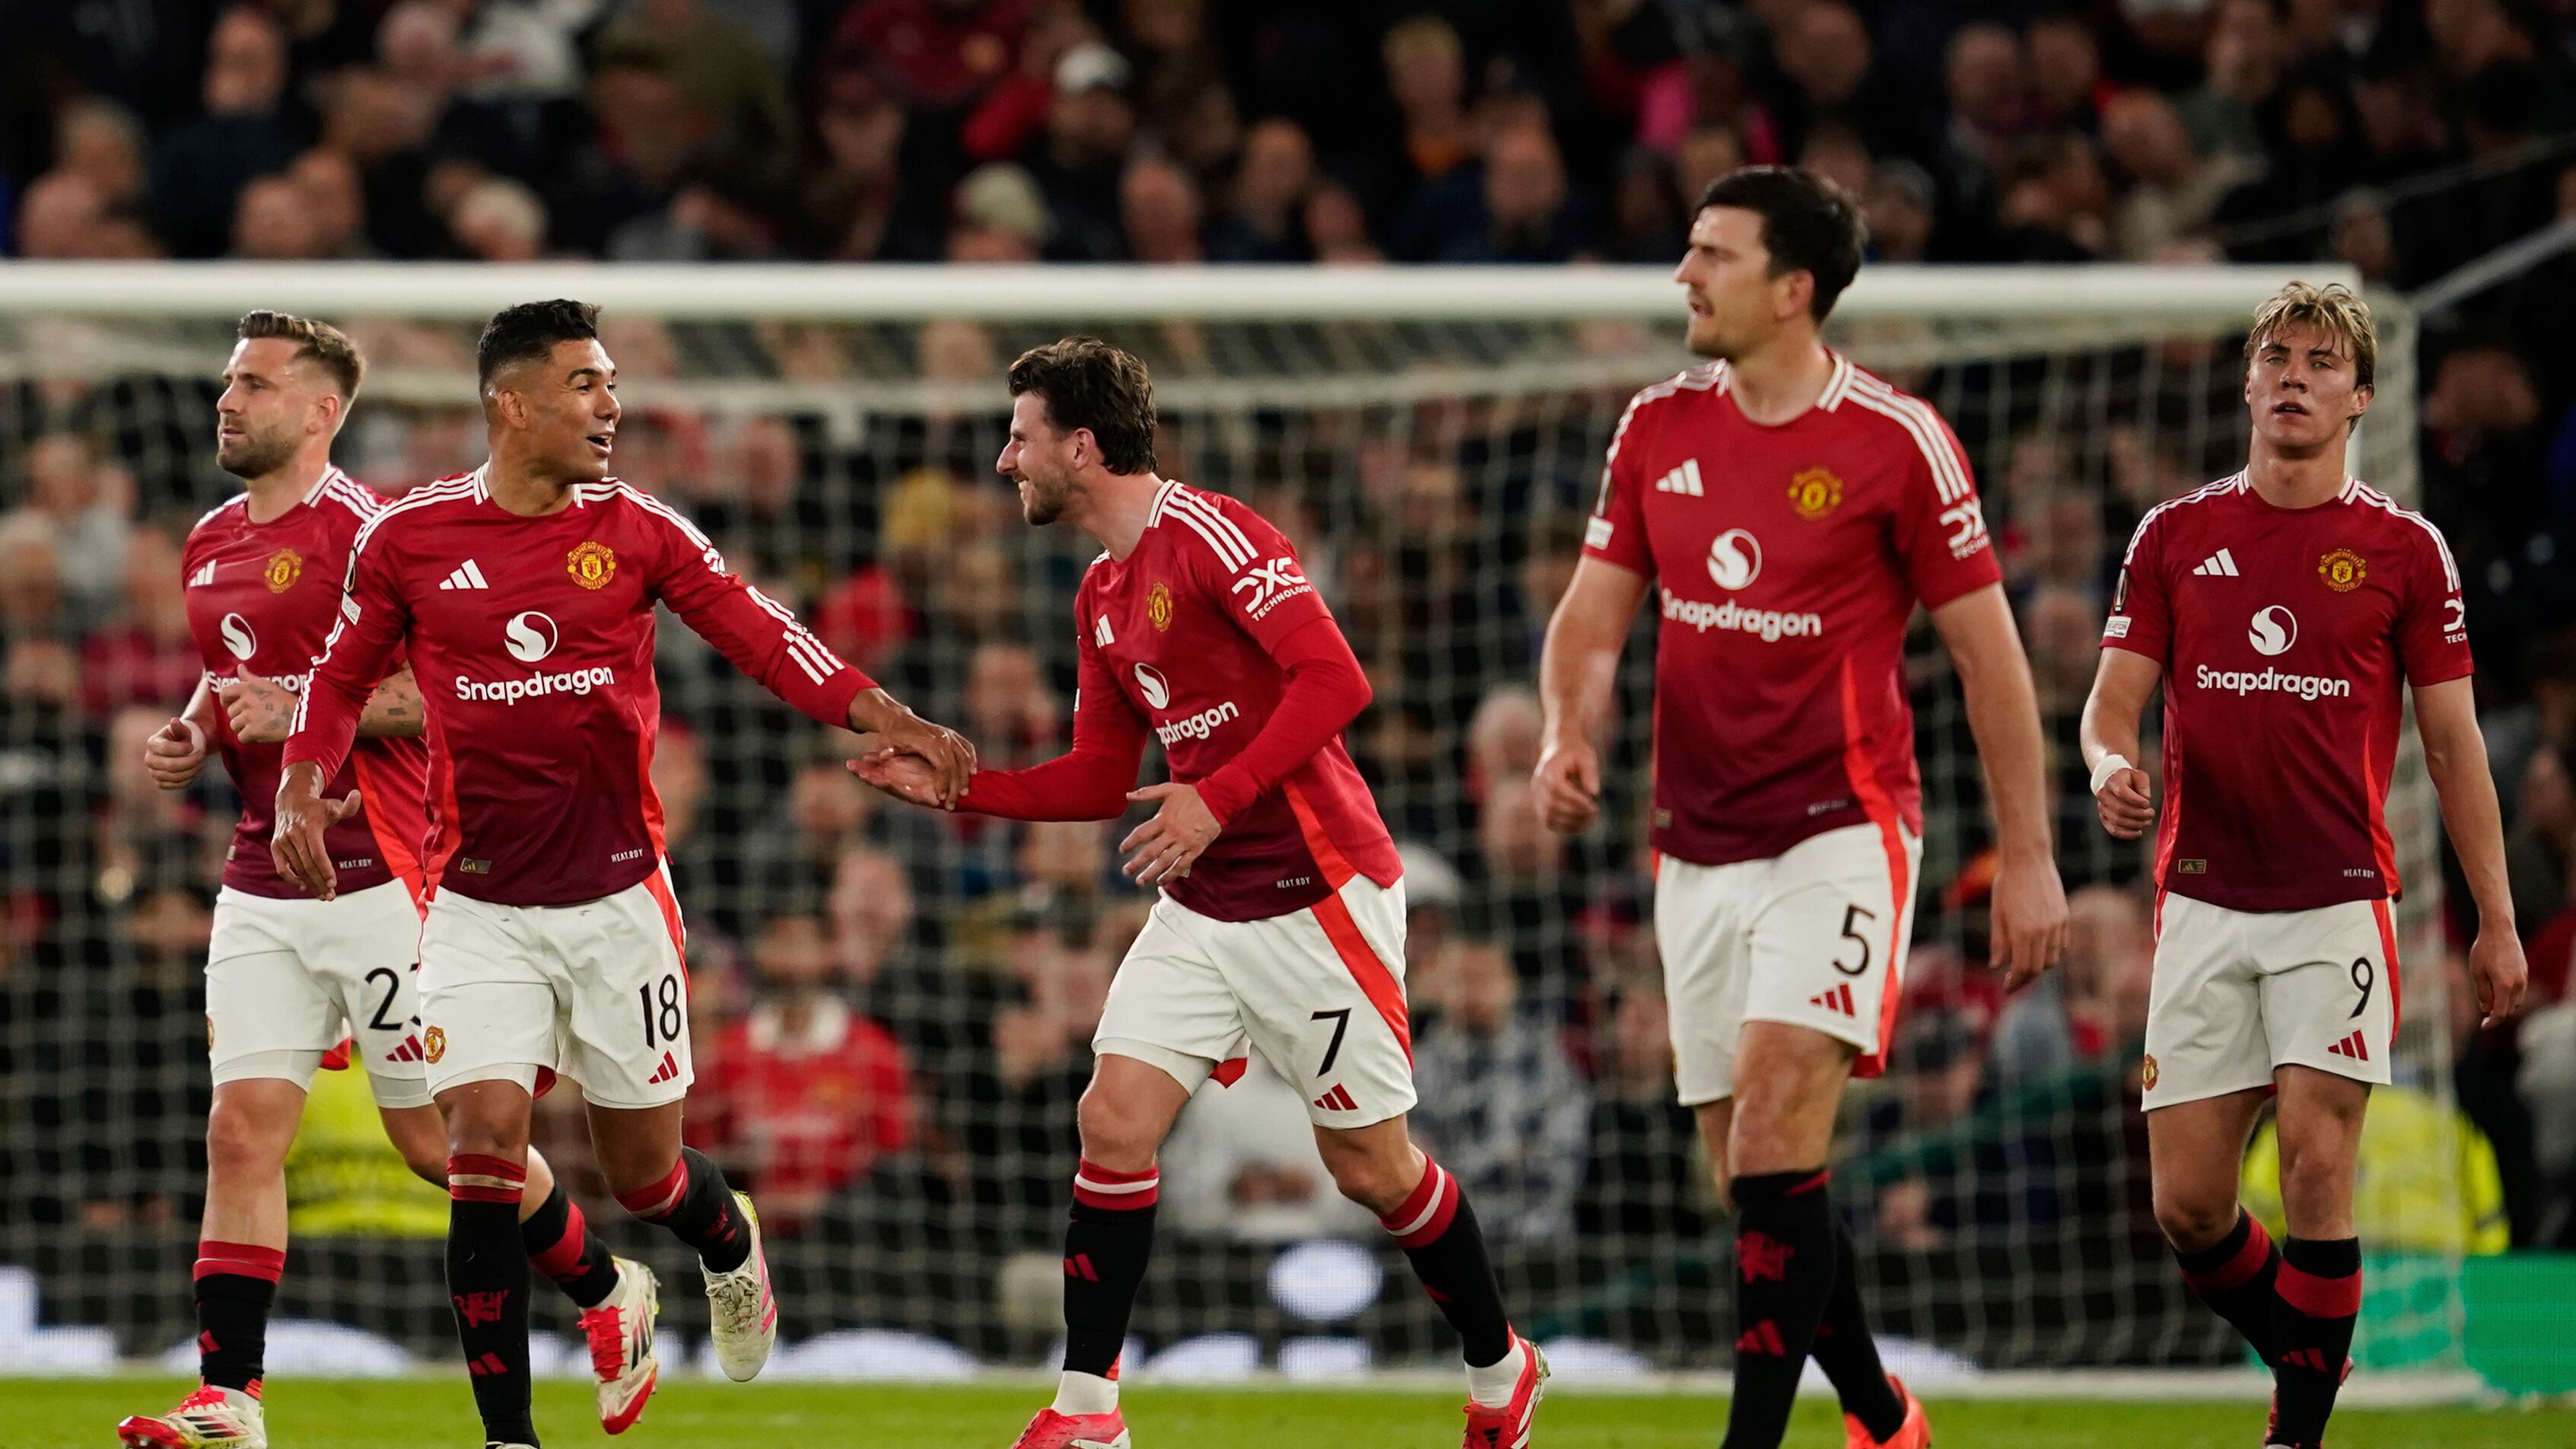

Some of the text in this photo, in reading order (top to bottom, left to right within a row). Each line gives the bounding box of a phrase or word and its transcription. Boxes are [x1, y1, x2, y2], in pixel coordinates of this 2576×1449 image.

[1232, 556, 1306, 613] DXC
[1251, 585, 1312, 621] TECHNOLOGY
[1662, 588, 1822, 642] Snapdragon
[456, 667, 615, 705] Snapdragon
[2197, 664, 2350, 701] Snapdragon
[1833, 904, 1875, 976] 5
[639, 974, 681, 1051] 18
[2348, 957, 2374, 1021] 9
[1311, 1008, 1352, 1078] 7
